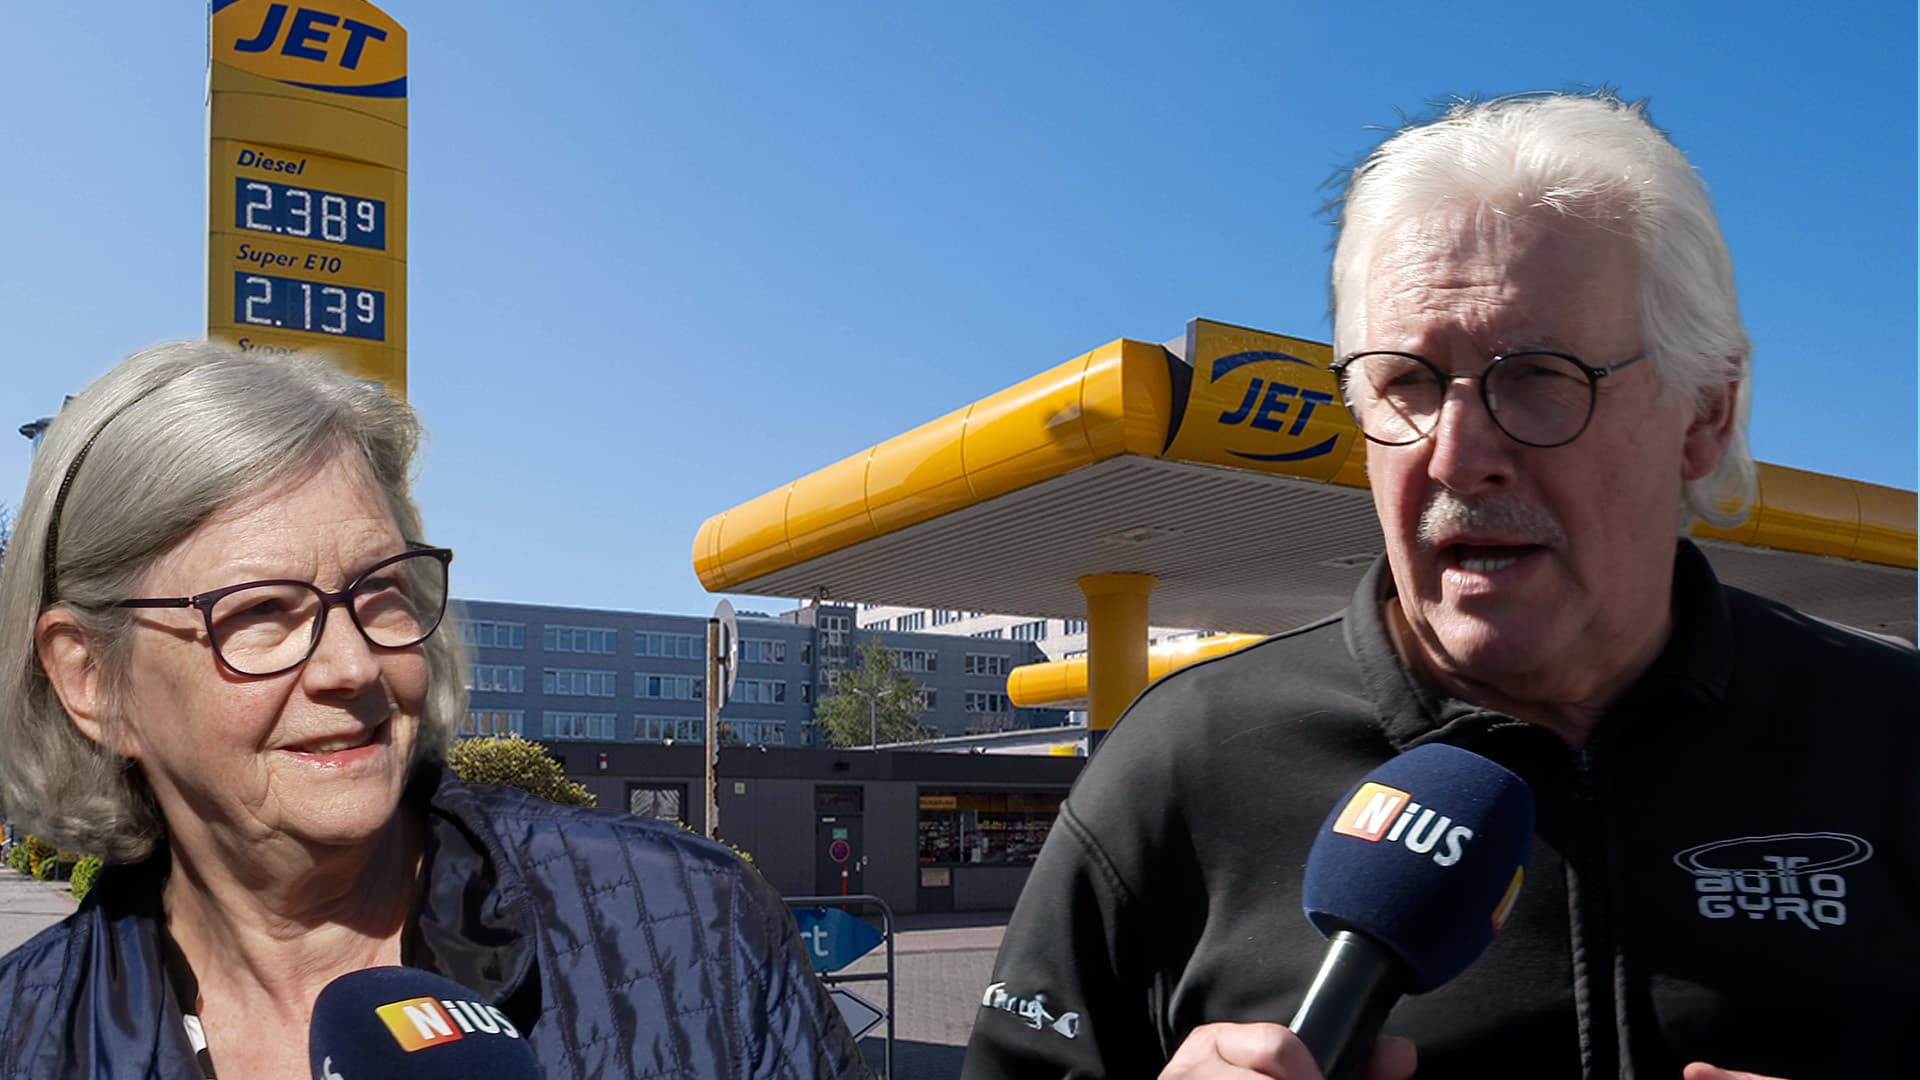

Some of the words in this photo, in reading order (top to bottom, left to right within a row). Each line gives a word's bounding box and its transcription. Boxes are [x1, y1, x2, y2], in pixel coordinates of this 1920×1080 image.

[234, 3, 387, 70] JET
[237, 149, 306, 175] Diesel
[236, 244, 298, 268] Super
[304, 254, 342, 273] E10
[1218, 378, 1333, 436] JET
[1698, 895, 1846, 930] GYRO
